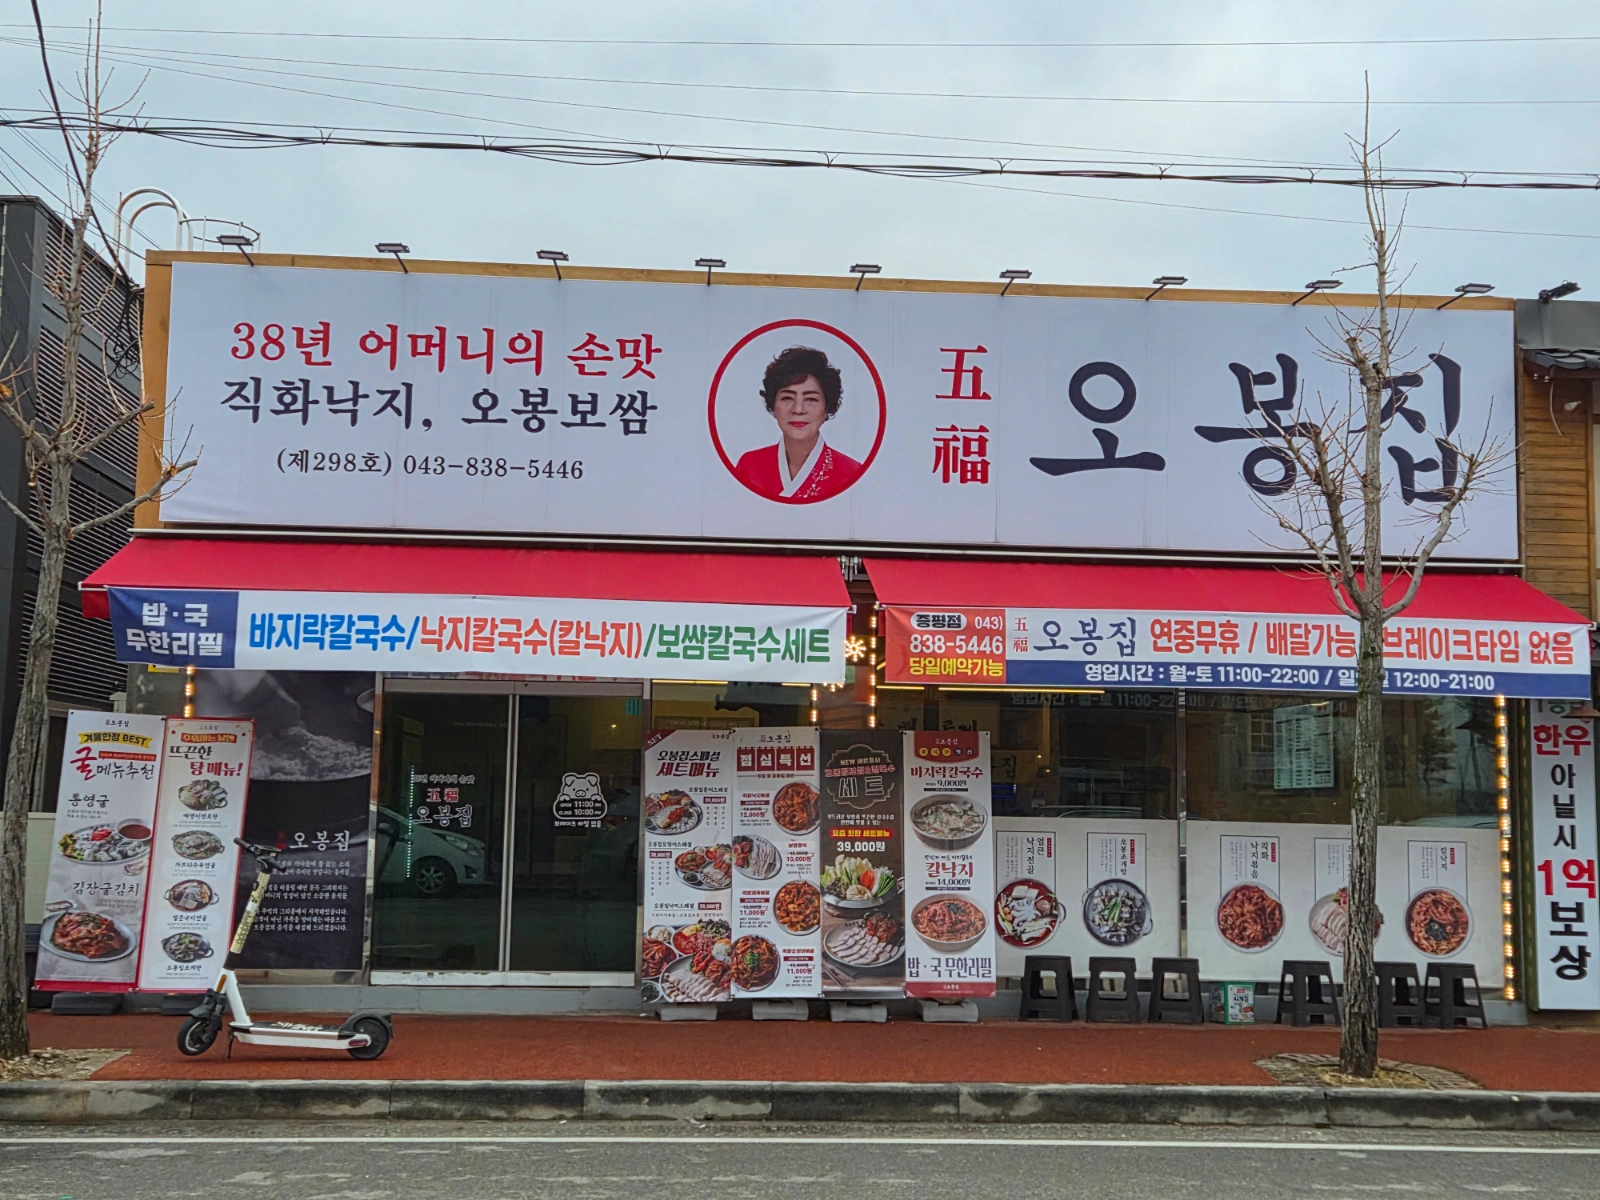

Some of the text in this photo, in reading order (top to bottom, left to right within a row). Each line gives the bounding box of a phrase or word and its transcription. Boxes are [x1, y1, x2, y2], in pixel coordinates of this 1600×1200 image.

[230, 321, 663, 380] 38년 어머니의 손맛
[220, 376, 658, 436] 직화낙지, 오봉보쌈
[1028, 351, 1462, 506] 오봉집
[276, 447, 584, 481] (제298호) 043-838-5446
[915, 612, 1004, 632] 증평점 043)
[126, 628, 224, 657] 무한리필
[909, 635, 1004, 656] 838-5446
[1032, 616, 1138, 658] 오봉집
[1149, 617, 1241, 655] 연중무휴
[1266, 621, 1357, 659] 배달가능
[1381, 626, 1521, 664] 브레이크타임
[1528, 630, 1575, 666] 없음
[908, 657, 1004, 678] 당일예약가능
[1084, 662, 1154, 683] 영업시간
[1217, 665, 1320, 686] 11:00-22:00
[1393, 671, 1495, 691] 12:00-21:00
[122, 733, 148, 748] BEST
[647, 732, 664, 747] SET
[1533, 724, 1592, 757] 한우
[96, 761, 156, 781] 메뉴추천
[655, 762, 721, 778] 세트메뉴
[910, 766, 983, 779] 바지락칼국수
[839, 776, 885, 798] 세트
[937, 779, 967, 788] 9,000원
[412, 804, 474, 828] 오봉집
[289, 830, 351, 852] 오봉집
[836, 841, 886, 852] 39,000원
[925, 862, 974, 878] 칼낙지
[1537, 858, 1597, 900] 1억
[1549, 900, 1592, 981] 보상
[945, 957, 992, 978] 무한리필
